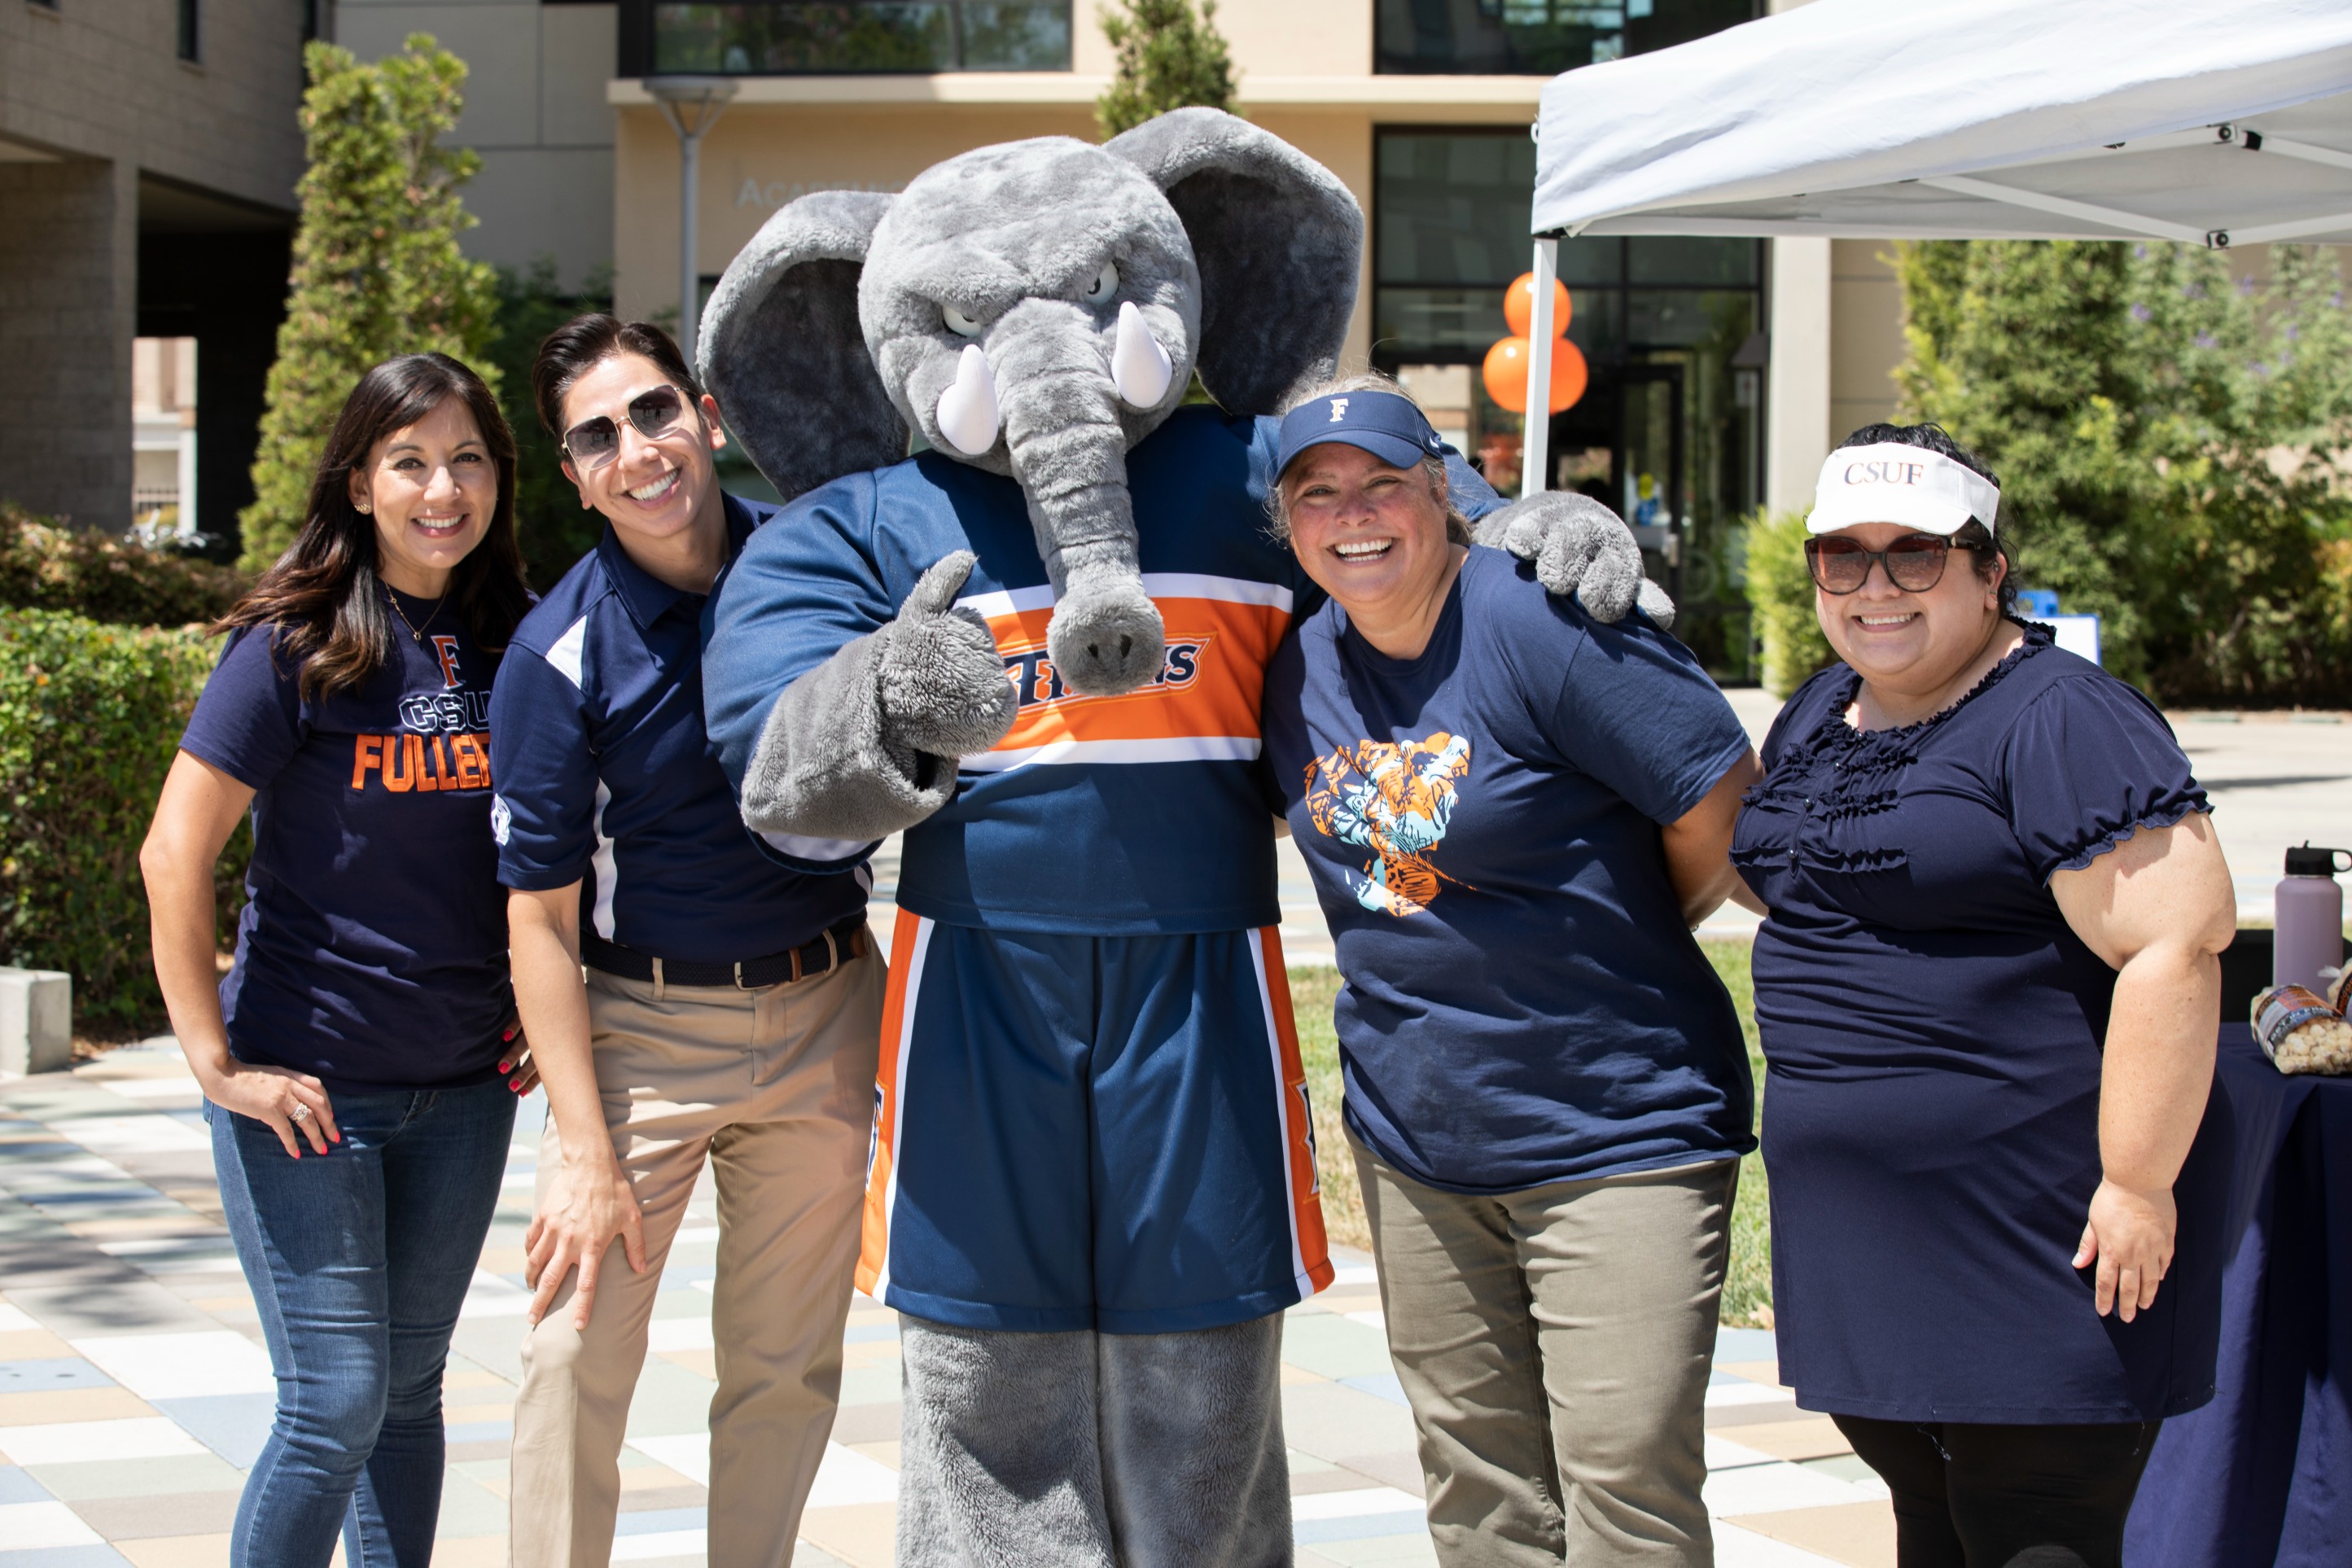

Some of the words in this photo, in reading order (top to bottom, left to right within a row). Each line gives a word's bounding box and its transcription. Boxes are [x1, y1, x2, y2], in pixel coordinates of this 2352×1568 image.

[1329, 397, 1349, 423] F
[1843, 461, 1925, 486] CSUF
[430, 635, 463, 690] F
